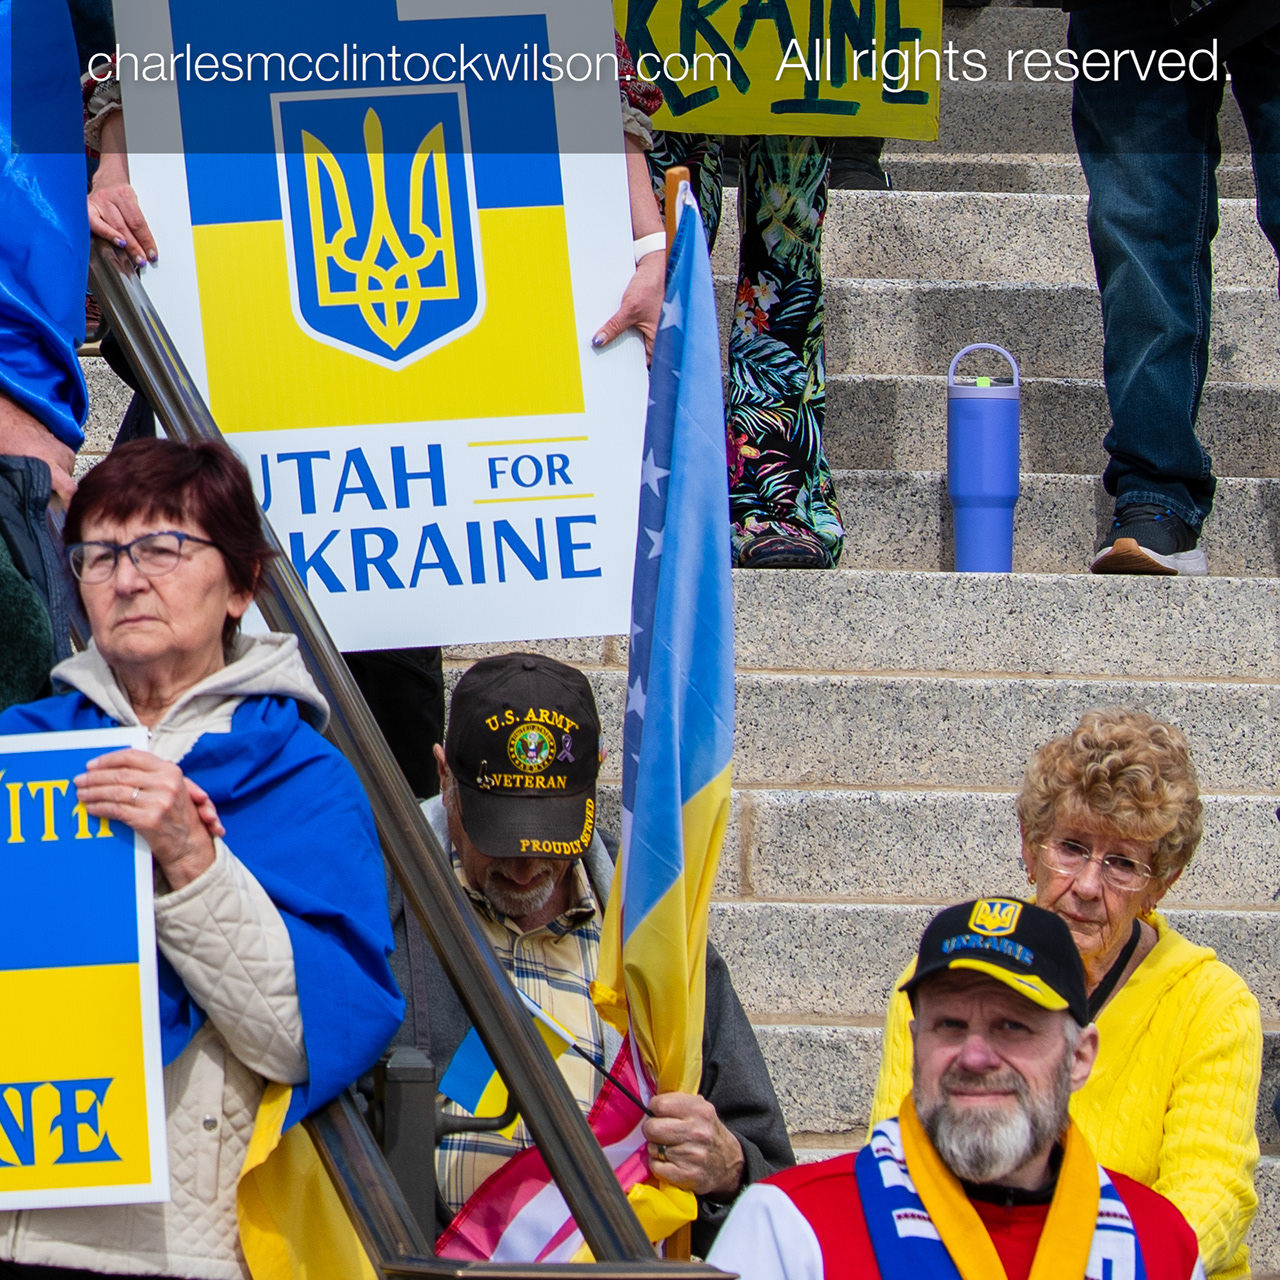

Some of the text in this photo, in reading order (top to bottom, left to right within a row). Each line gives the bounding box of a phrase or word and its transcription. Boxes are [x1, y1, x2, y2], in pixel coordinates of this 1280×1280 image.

[487, 452, 574, 490] FOR
[288, 513, 603, 594] KRAINE
[485, 709, 520, 731] U.S.
[523, 707, 576, 734] ARMY
[492, 773, 568, 789] VETERAN
[519, 797, 596, 856] PROUDLY SERVED
[941, 933, 1034, 966] UKRAINE
